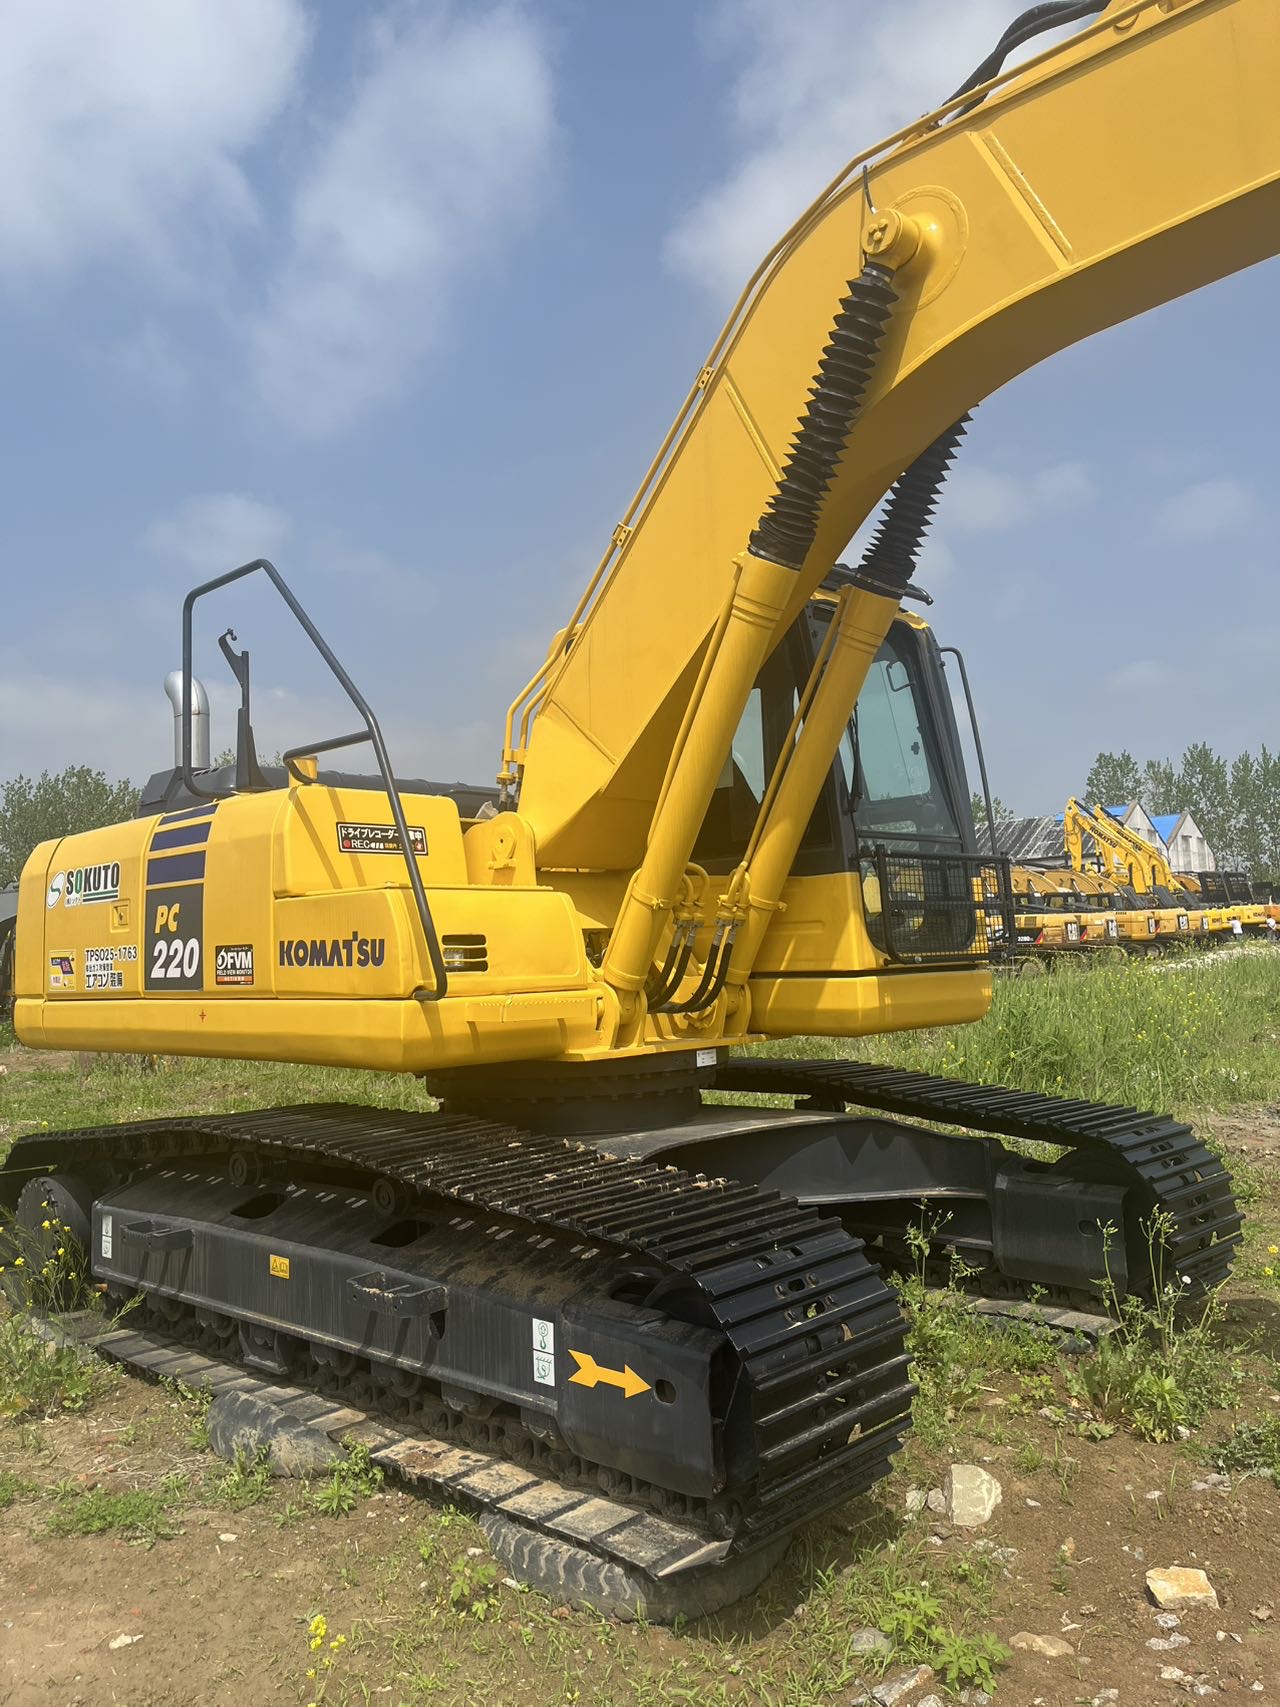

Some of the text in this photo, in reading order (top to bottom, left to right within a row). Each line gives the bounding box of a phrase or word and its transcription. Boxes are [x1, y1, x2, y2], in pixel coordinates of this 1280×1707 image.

[351, 839, 370, 849] REC
[1090, 826, 1117, 848] KOMATSU
[66, 862, 120, 896] SOKUTO
[154, 903, 180, 934] PC
[150, 938, 200, 979] 220
[227, 951, 252, 969] FVM
[279, 931, 385, 967] KOMATSU
